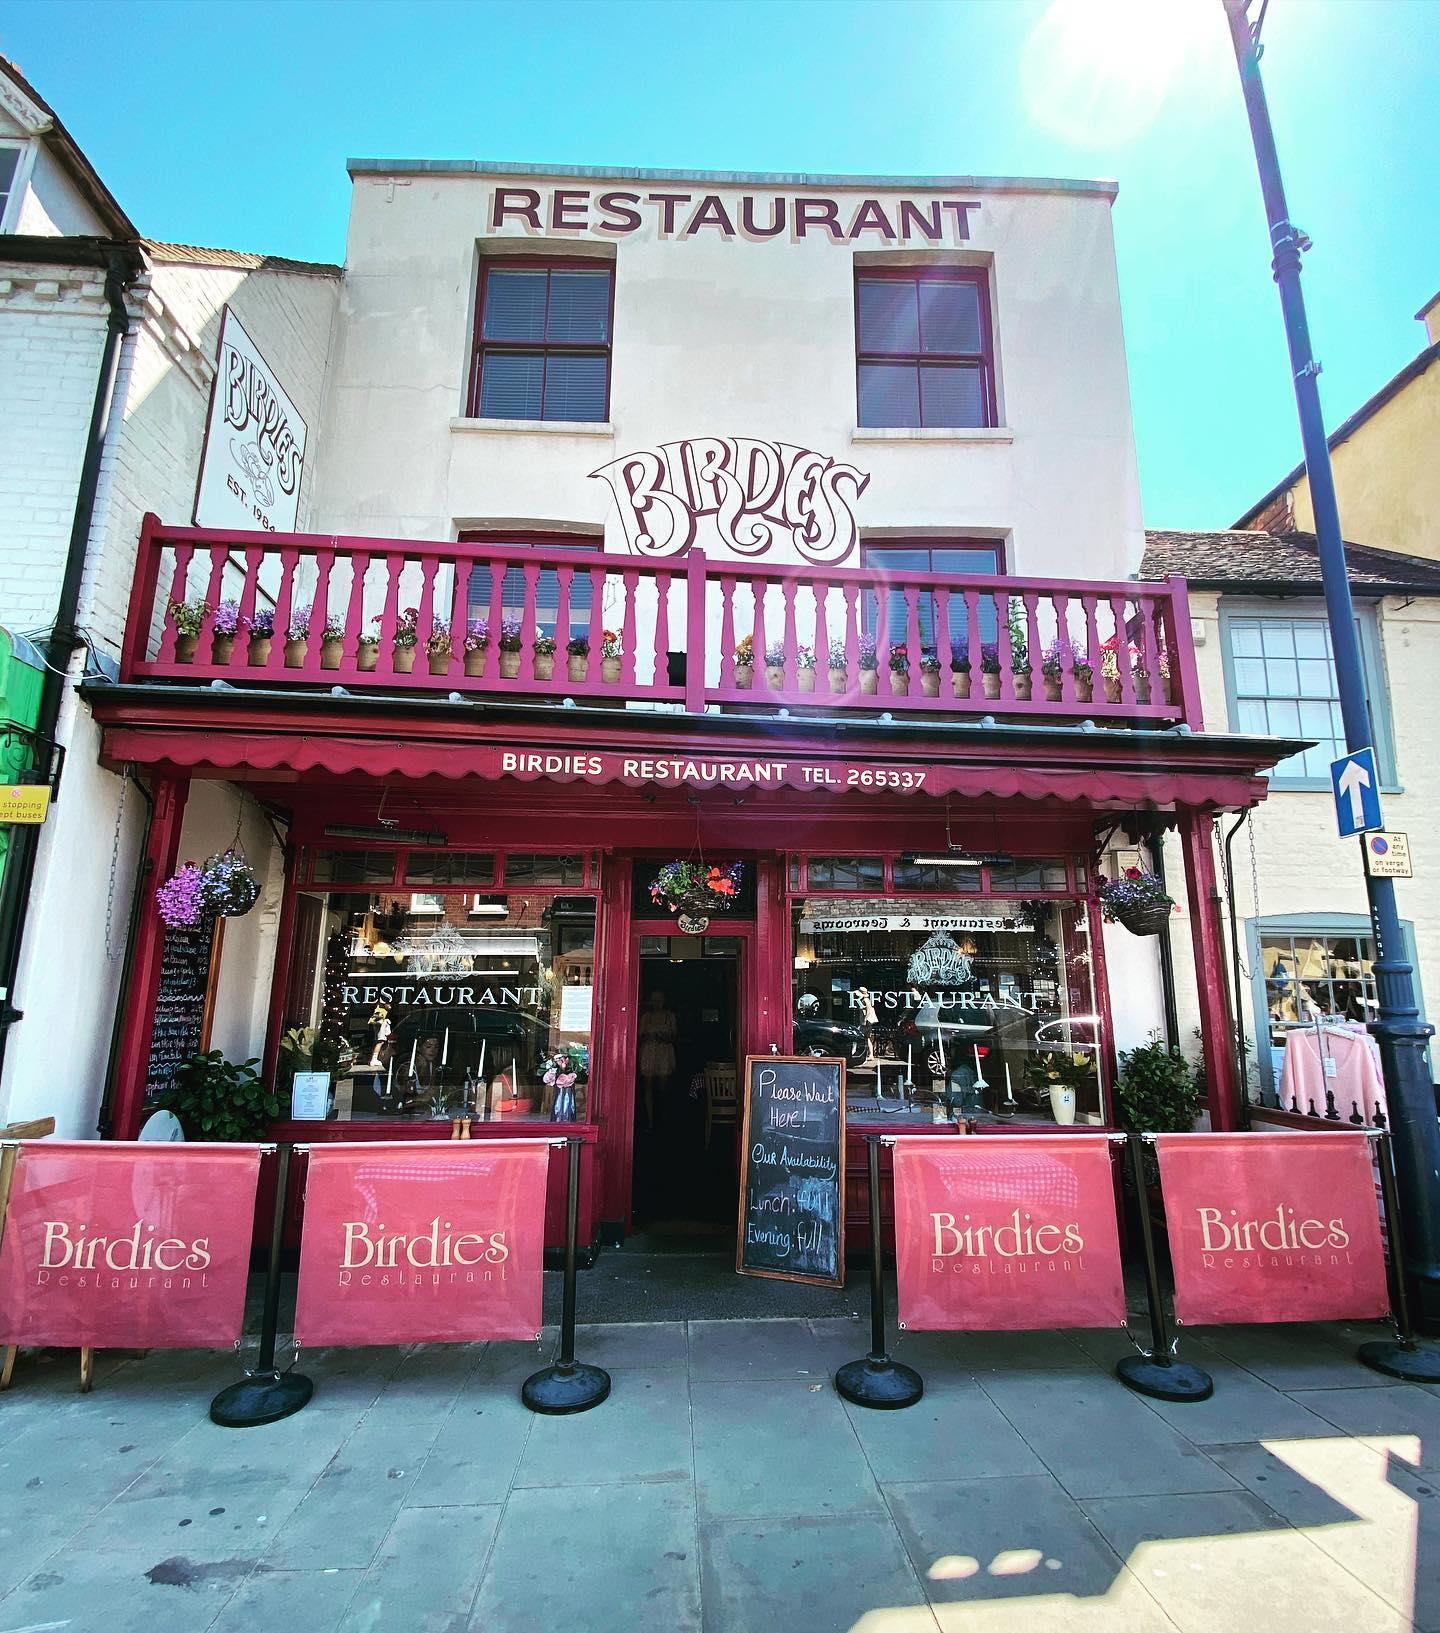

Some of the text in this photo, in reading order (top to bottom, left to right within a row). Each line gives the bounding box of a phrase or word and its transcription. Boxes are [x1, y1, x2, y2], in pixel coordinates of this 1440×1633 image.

[488, 187, 981, 244] RESTAURANT
[223, 341, 304, 496] BIRDIES
[226, 474, 249, 508] EST.
[587, 437, 870, 566] BIRDIES
[502, 752, 927, 791] BIRDIES RESTAURANT TEL. 265337
[2, 801, 42, 809] stopping
[16, 811, 42, 819] buses
[1381, 866, 1408, 874] footway
[340, 986, 543, 1006] RESTAURANT
[848, 991, 1041, 1010] RESTAURANT
[759, 1069, 835, 1103] Please Wait
[770, 1106, 807, 1128] Here!
[780, 1145, 837, 1181] Availability
[339, 1216, 509, 1268] Birdies
[797, 1221, 823, 1255] full
[930, 1207, 1084, 1257] Birdies
[1196, 1202, 1350, 1251] Birdies
[38, 1218, 212, 1271] Birdies
[1202, 1251, 1354, 1269] Restaurant
[37, 1270, 209, 1289] Restaurant
[339, 1266, 508, 1287] Restaurant
[932, 1256, 1086, 1274] Restaurant
